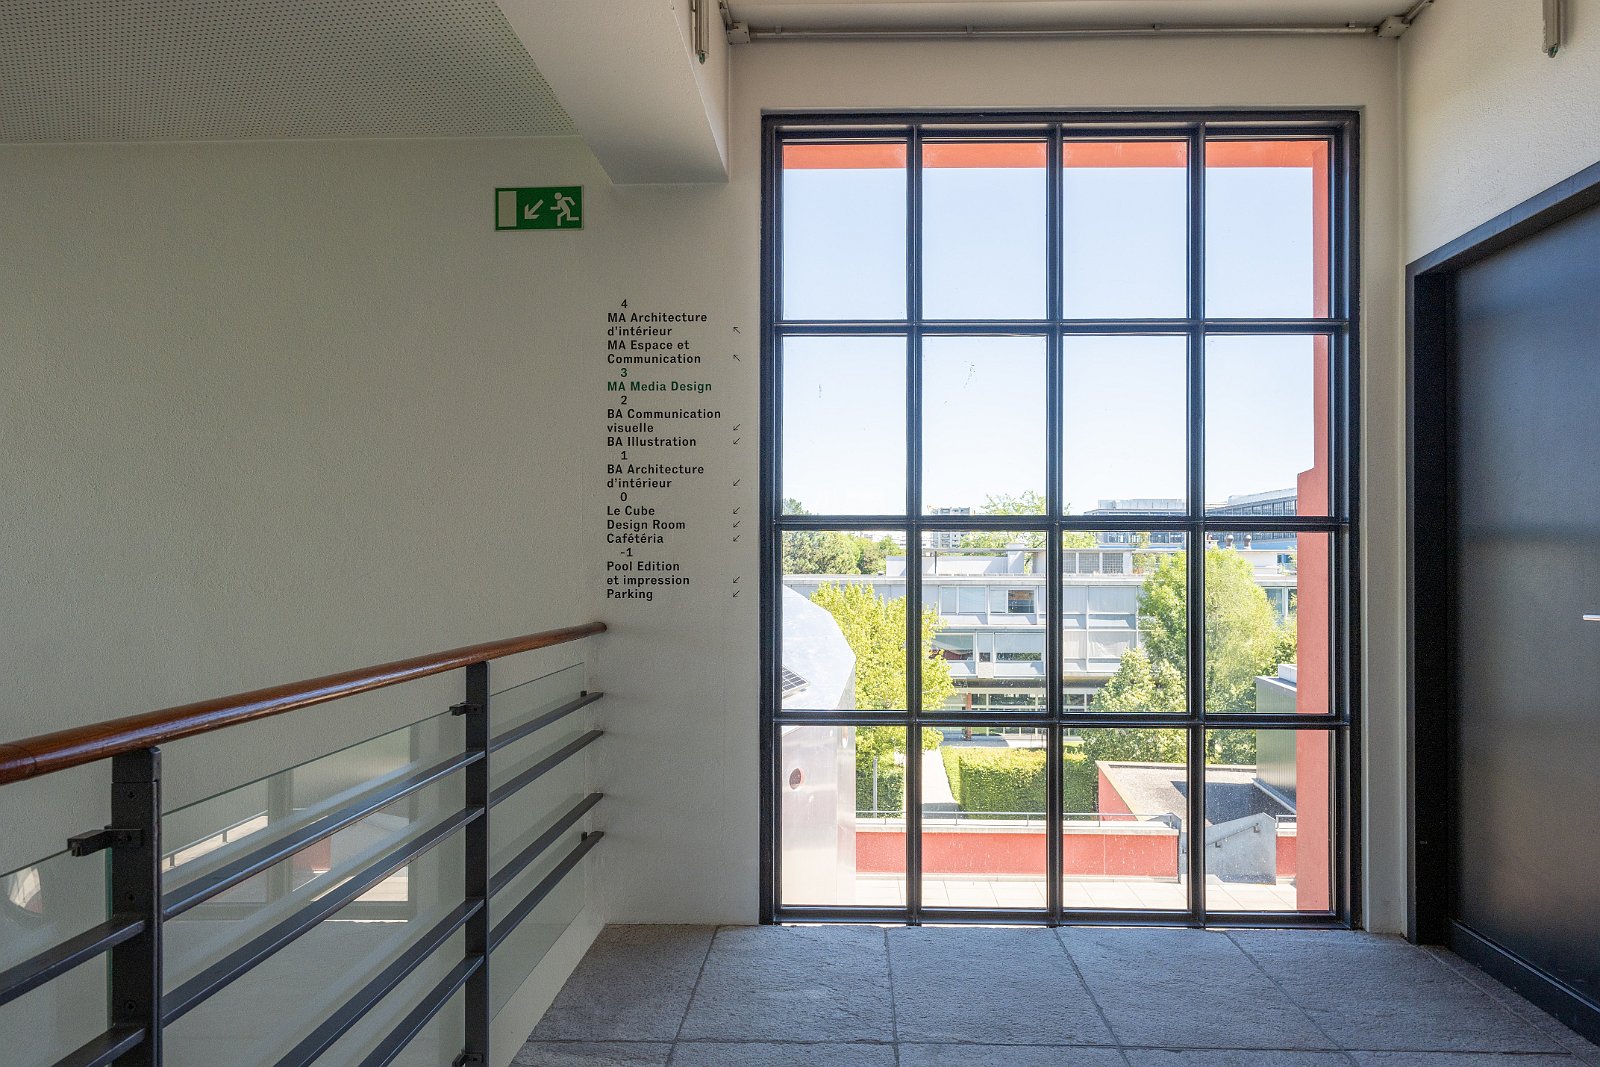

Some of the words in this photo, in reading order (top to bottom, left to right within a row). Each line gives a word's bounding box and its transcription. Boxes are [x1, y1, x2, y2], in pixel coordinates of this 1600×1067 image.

[620, 299, 628, 308] 4
[607, 313, 627, 322] MA
[630, 312, 708, 322] Architecture
[607, 326, 673, 336] d'intérieur
[607, 340, 627, 350] MA
[631, 340, 674, 352] Espace
[678, 340, 690, 349] et
[607, 354, 701, 363] Communication
[620, 368, 628, 377] 3
[607, 381, 626, 391] MA
[631, 381, 667, 391] Media
[671, 381, 712, 393] Design
[620, 396, 628, 405] 2
[607, 409, 624, 418] BA
[628, 409, 721, 418] Communication
[606, 423, 654, 432] visuelle
[607, 437, 624, 446] BA
[628, 437, 697, 446] Illustration
[620, 451, 628, 460] 1
[607, 464, 623, 474] BA
[627, 464, 705, 474] Architecture
[606, 506, 621, 515] Le
[625, 506, 656, 515] Cube
[606, 520, 648, 532] Design
[653, 520, 686, 529] Room
[606, 533, 664, 543] Cafétéria
[620, 548, 633, 557] -1
[606, 561, 633, 571] Pool
[638, 561, 680, 571] Edition
[606, 576, 620, 585] et
[624, 575, 690, 587] impression
[606, 589, 653, 601] Parking
